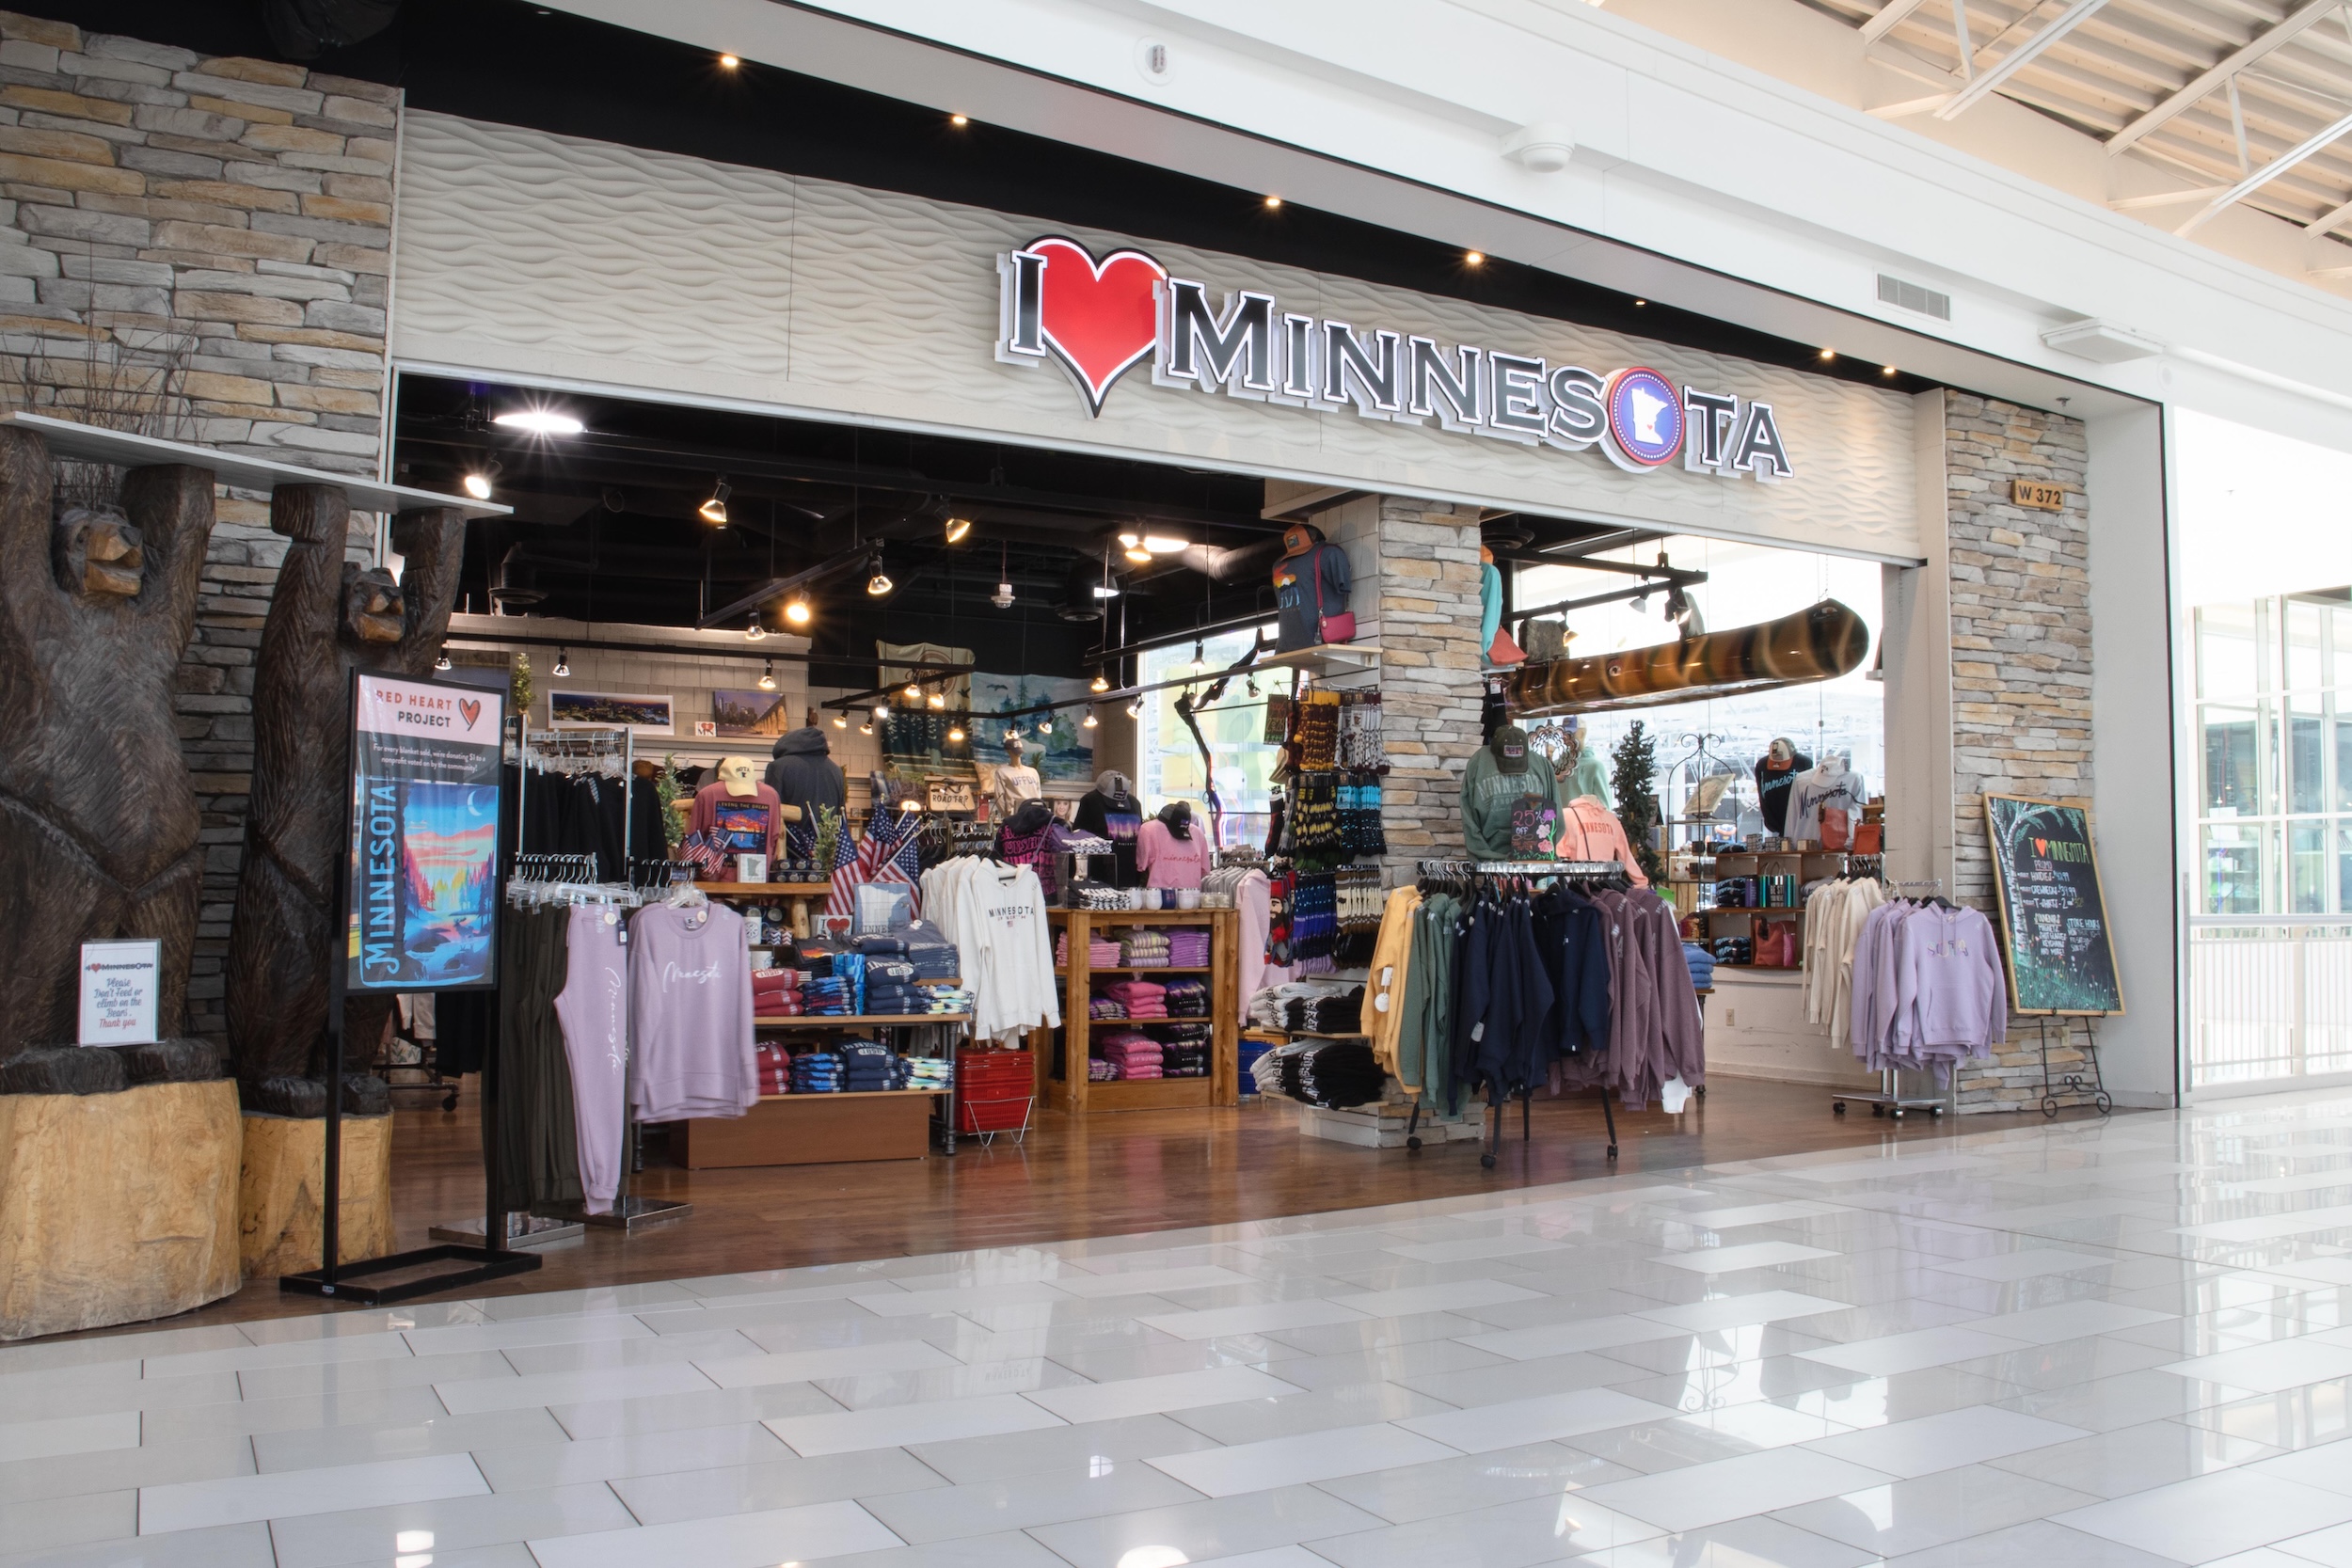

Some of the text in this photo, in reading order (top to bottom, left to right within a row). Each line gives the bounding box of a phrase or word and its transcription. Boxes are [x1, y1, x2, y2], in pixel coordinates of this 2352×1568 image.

[1005, 248, 1795, 478] I MINNESOTA
[2018, 485, 2061, 505] W 372
[376, 689, 452, 710] RED HEART
[398, 711, 451, 728] PROJECT
[383, 747, 399, 755] every
[399, 746, 420, 755] blanket
[420, 749, 432, 757] sold,
[446, 751, 469, 763] donating
[381, 756, 407, 766] nonprofit
[431, 760, 437, 769] by
[447, 763, 478, 774] community!
[2028, 837, 2090, 863] I MINNESOTA
[364, 784, 401, 974] MINNESOTA
[989, 906, 1035, 918] MINNESOTA
[102, 962, 153, 971] MINNESOTA
[106, 978, 131, 987] Please
[94, 989, 114, 998] Don't
[97, 999, 118, 1008] climb
[131, 998, 142, 1006] the
[100, 1019, 136, 1029] Thank you
